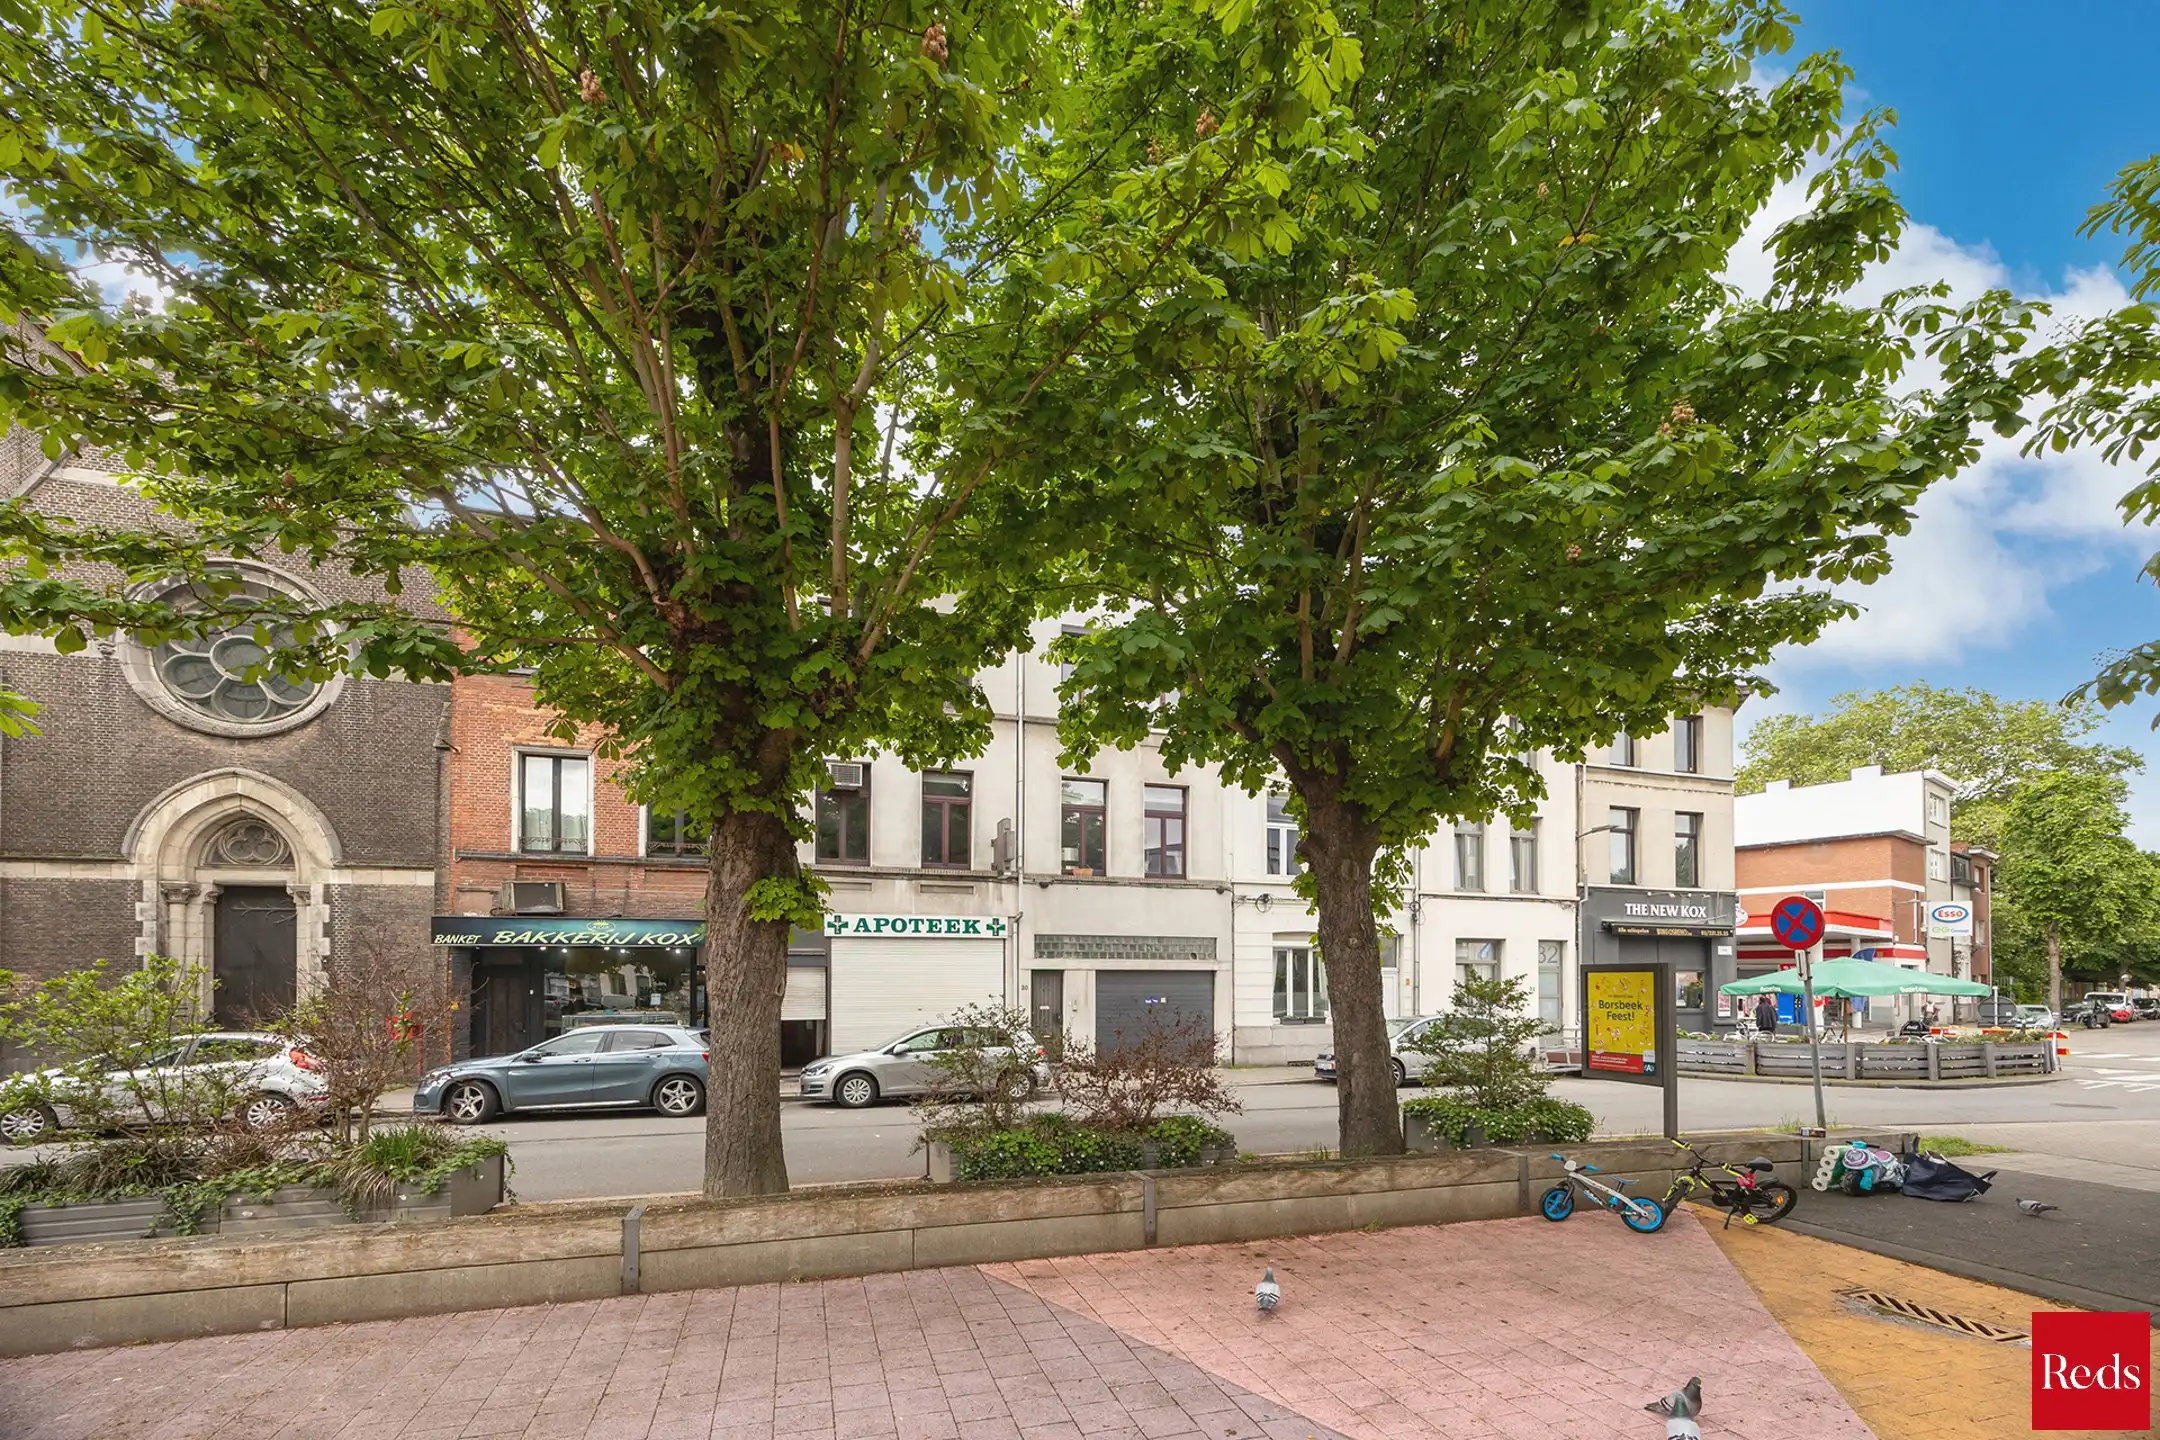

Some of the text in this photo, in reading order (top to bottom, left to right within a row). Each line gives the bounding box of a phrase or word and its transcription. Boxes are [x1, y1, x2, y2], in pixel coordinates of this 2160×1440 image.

[1624, 903, 1707, 918] THE NEW KOX
[853, 917, 981, 935] APOTEEK
[434, 930, 700, 945] BANKET BAKKERIJ KOX
[1598, 999, 1643, 1010] Borsbeek
[1606, 1011, 1635, 1021] Feest!
